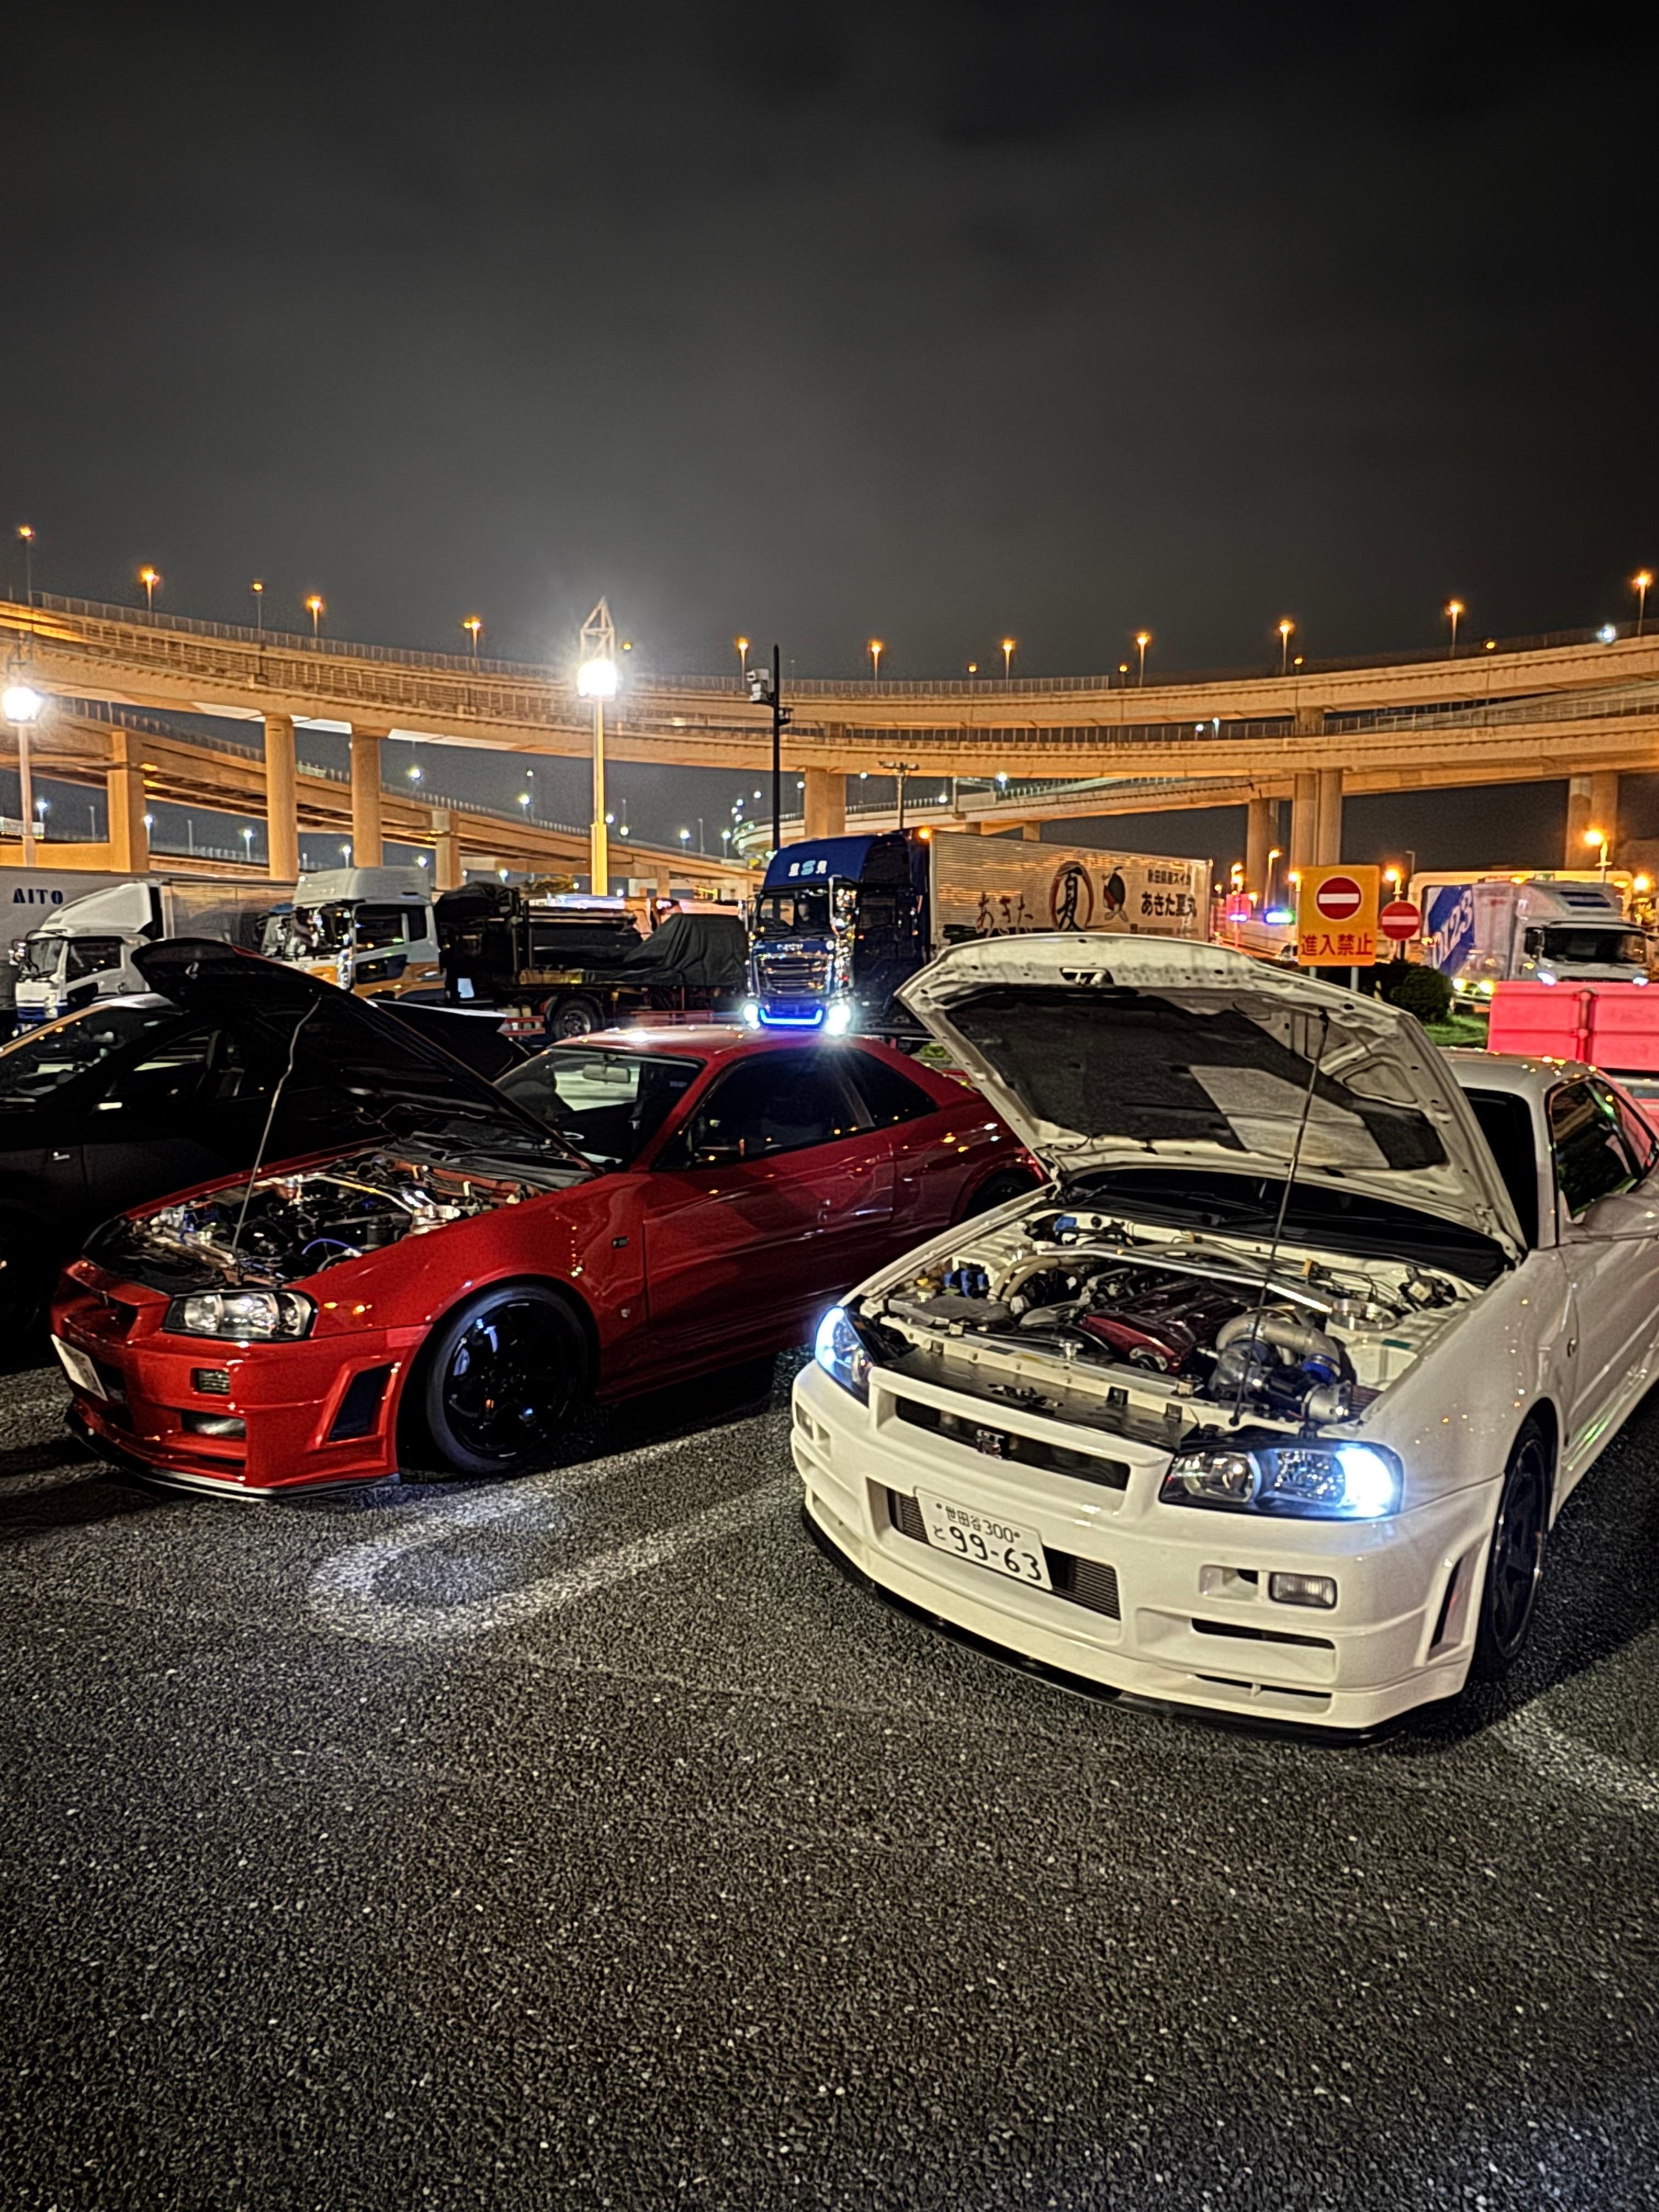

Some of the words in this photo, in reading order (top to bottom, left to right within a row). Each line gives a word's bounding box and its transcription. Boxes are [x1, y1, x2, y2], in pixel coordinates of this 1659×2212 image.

[1301, 933, 1373, 956] 進入禁止
[949, 1526, 1041, 1581] 99-63
